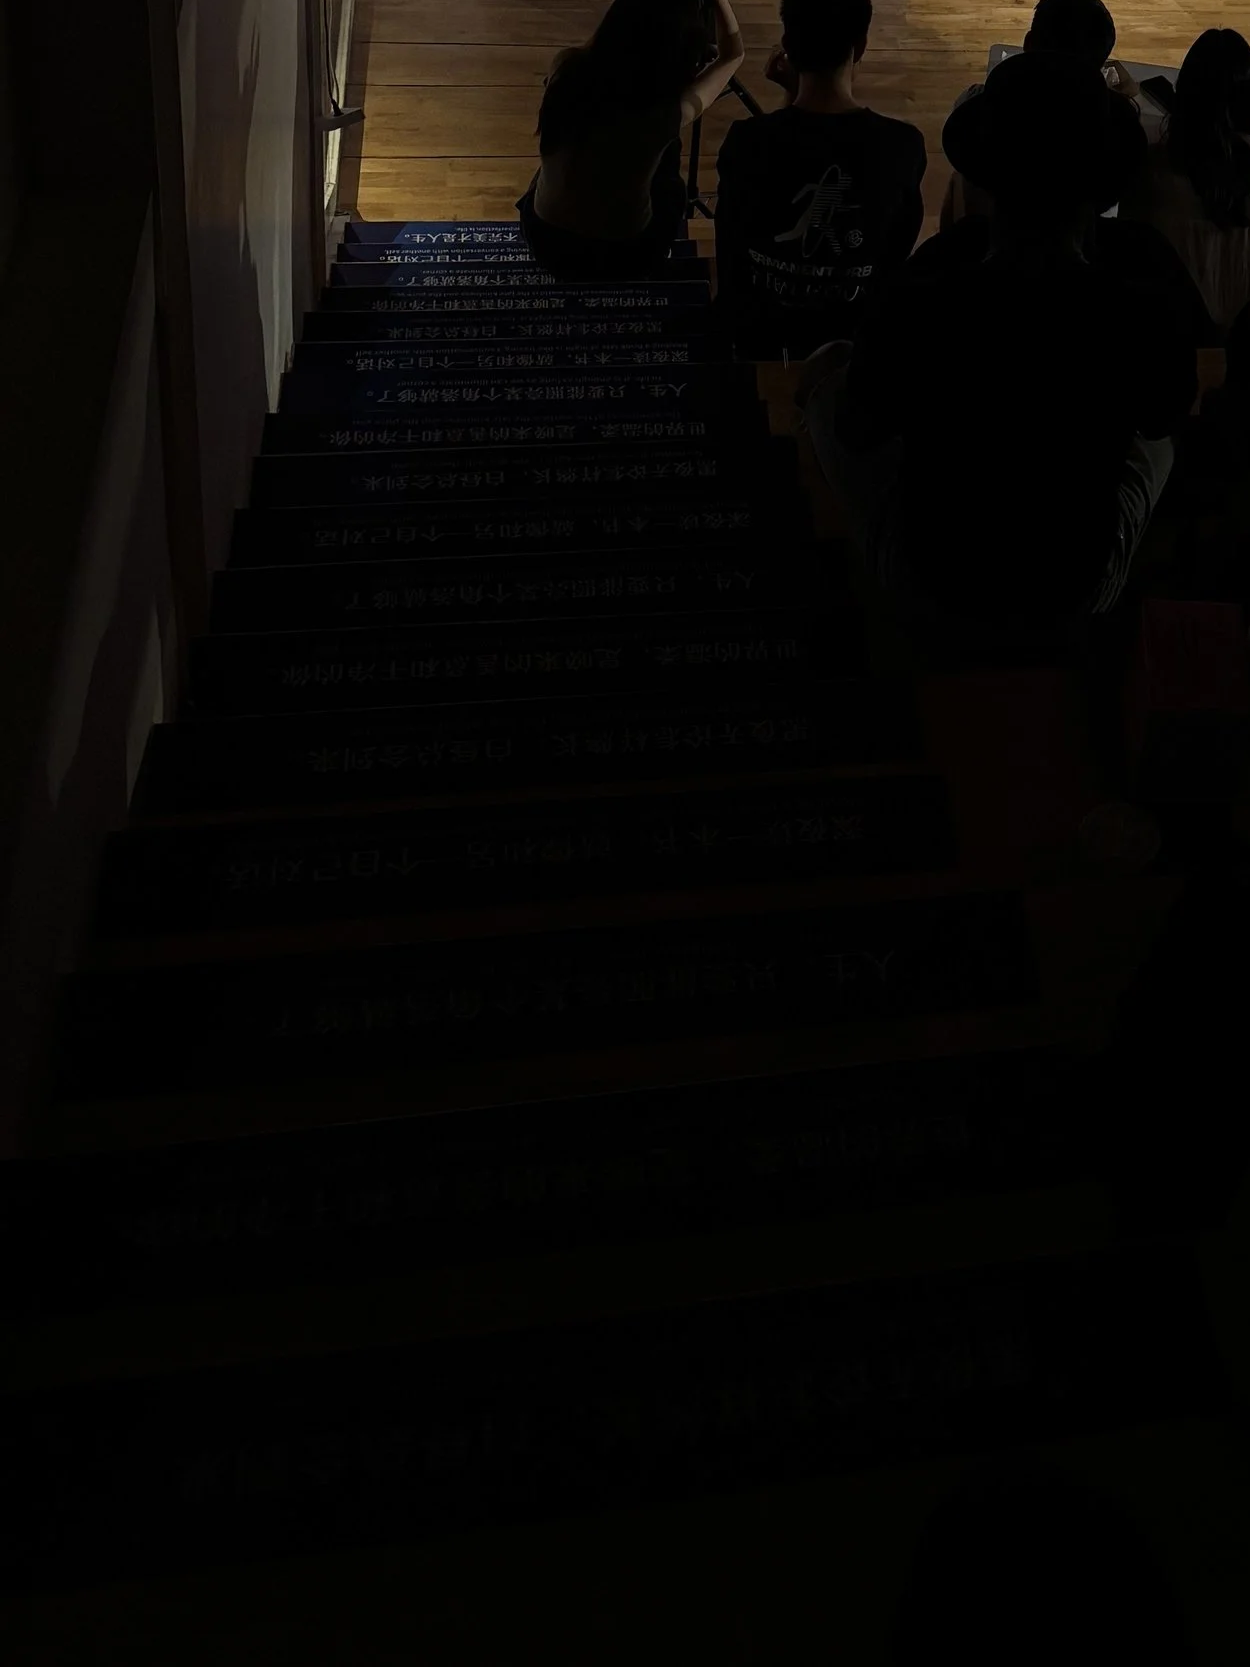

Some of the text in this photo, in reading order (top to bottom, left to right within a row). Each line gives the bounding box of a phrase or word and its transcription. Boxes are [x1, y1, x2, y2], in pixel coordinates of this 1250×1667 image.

[405, 233, 518, 243] 不完美才是人生。
